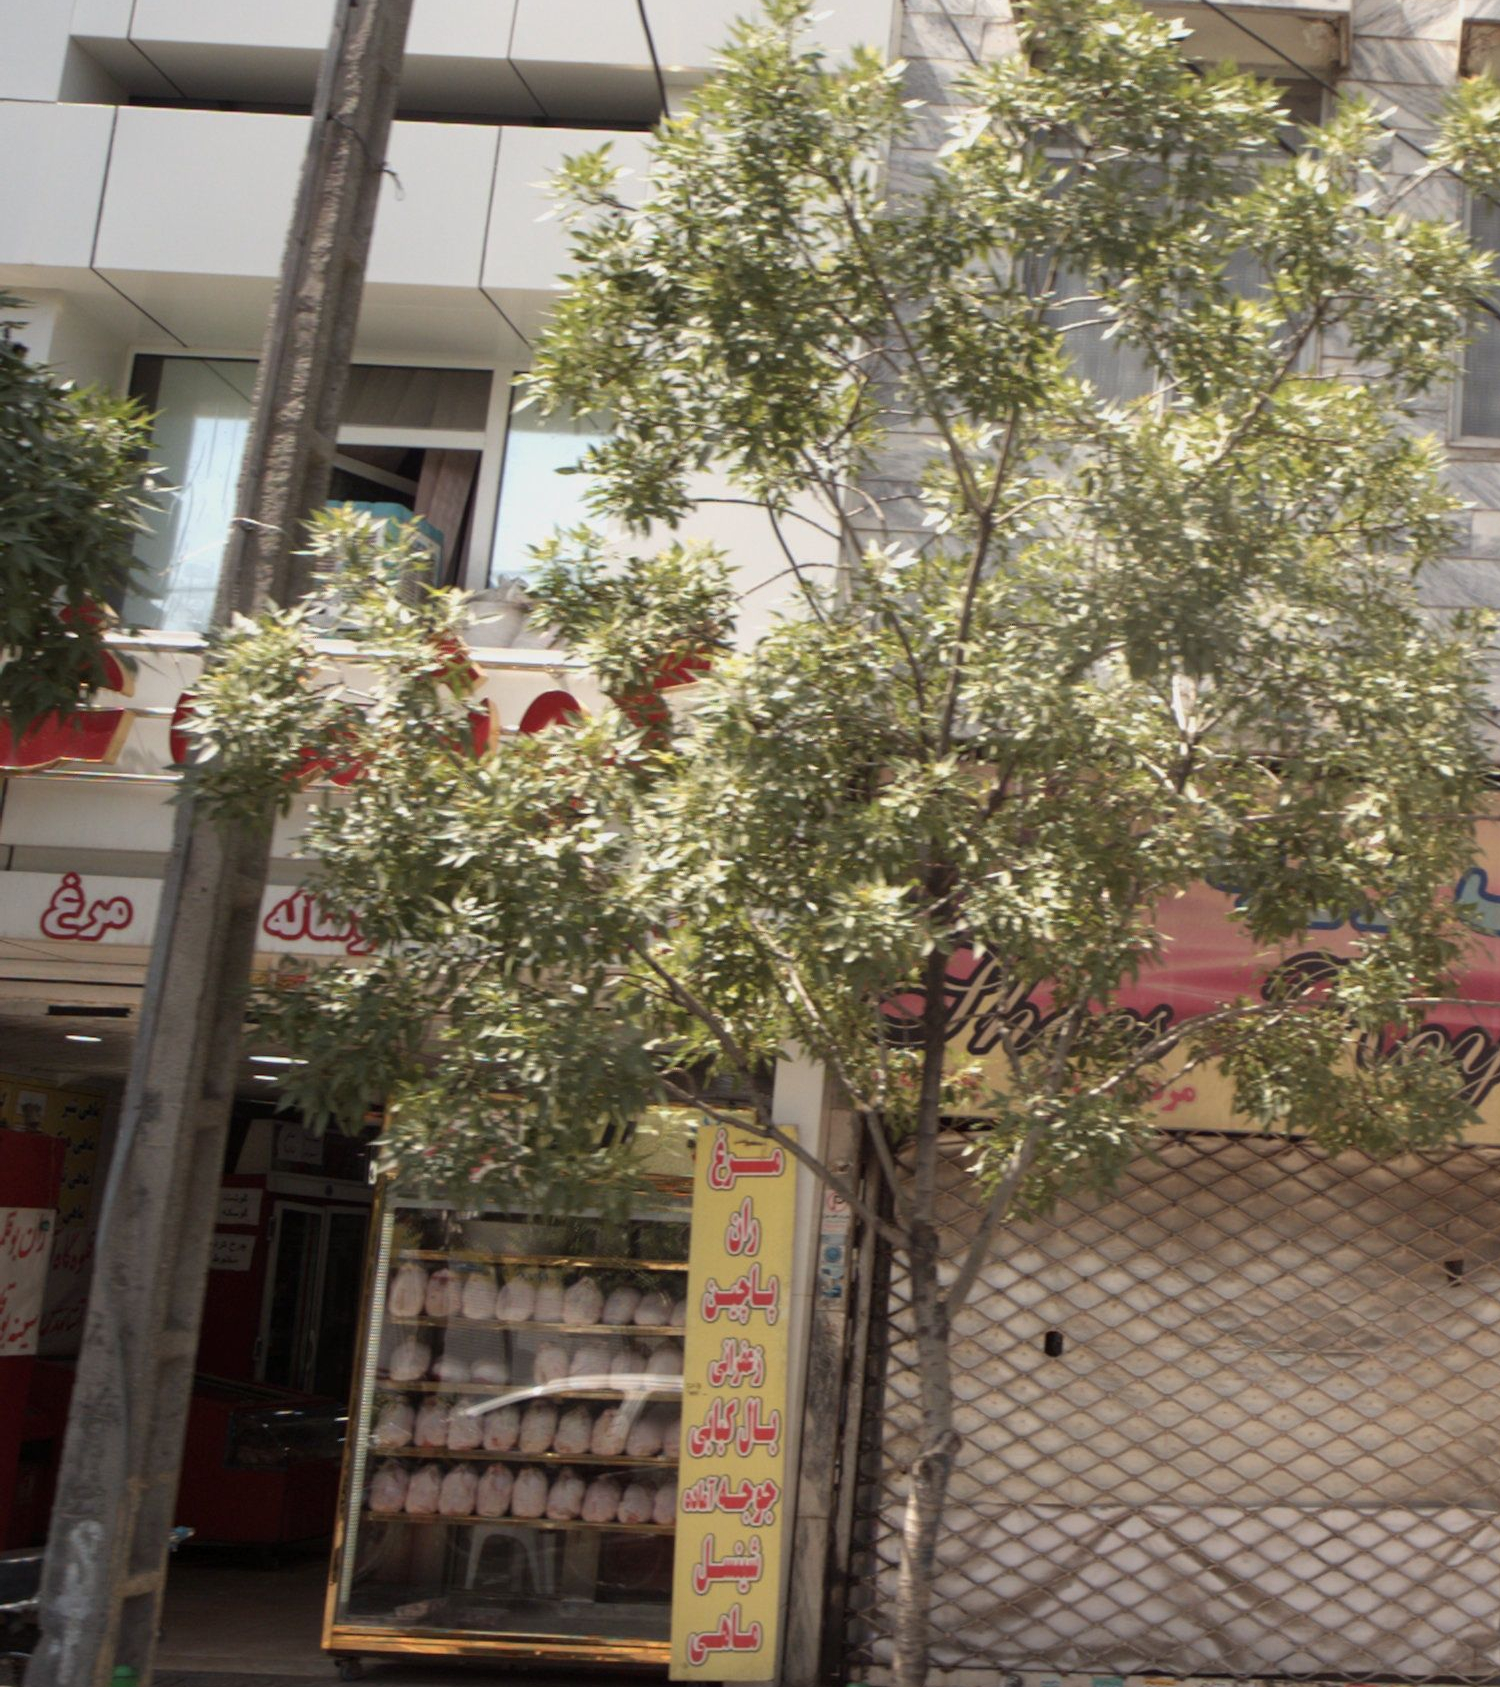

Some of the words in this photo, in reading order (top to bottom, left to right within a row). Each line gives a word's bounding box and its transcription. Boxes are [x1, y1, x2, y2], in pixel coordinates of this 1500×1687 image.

[40, 871, 133, 941] مرغ
[708, 1128, 784, 1189] مرغ
[726, 1196, 760, 1255] ران
[708, 1338, 765, 1386] زعفرانی
[689, 1397, 738, 1457] کبابی
[736, 1397, 780, 1457] بال
[718, 1475, 778, 1526] جوجه
[688, 1603, 762, 1666] ماهی
